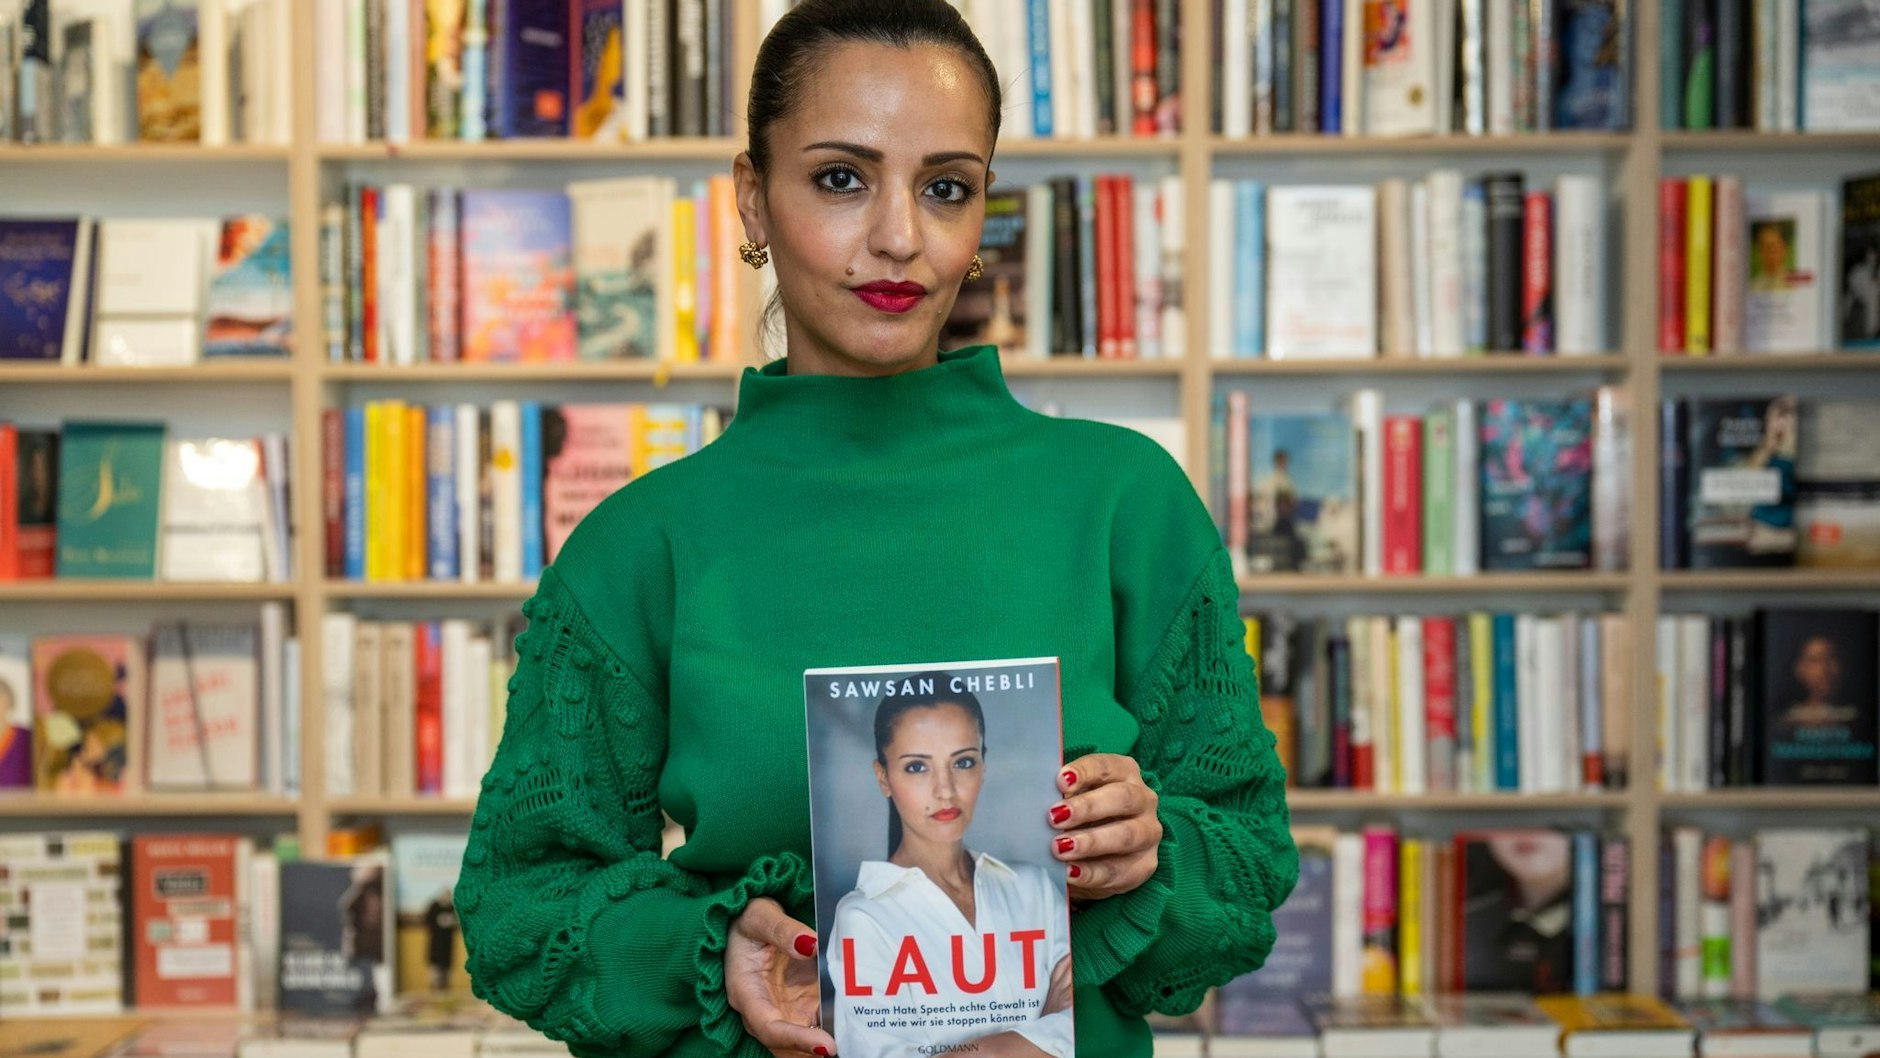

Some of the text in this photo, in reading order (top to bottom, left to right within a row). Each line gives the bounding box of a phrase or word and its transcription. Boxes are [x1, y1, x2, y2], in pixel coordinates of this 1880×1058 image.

[829, 672, 1034, 698] SAWSAN CHEBLI
[842, 929, 1046, 996] LAUT
[853, 998, 1040, 1016] Warum Hate Speech echte Gewalt ist
[867, 1013, 1027, 1028] und wie wir sie stoppen können
[917, 1043, 979, 1056] GOLDMANN
